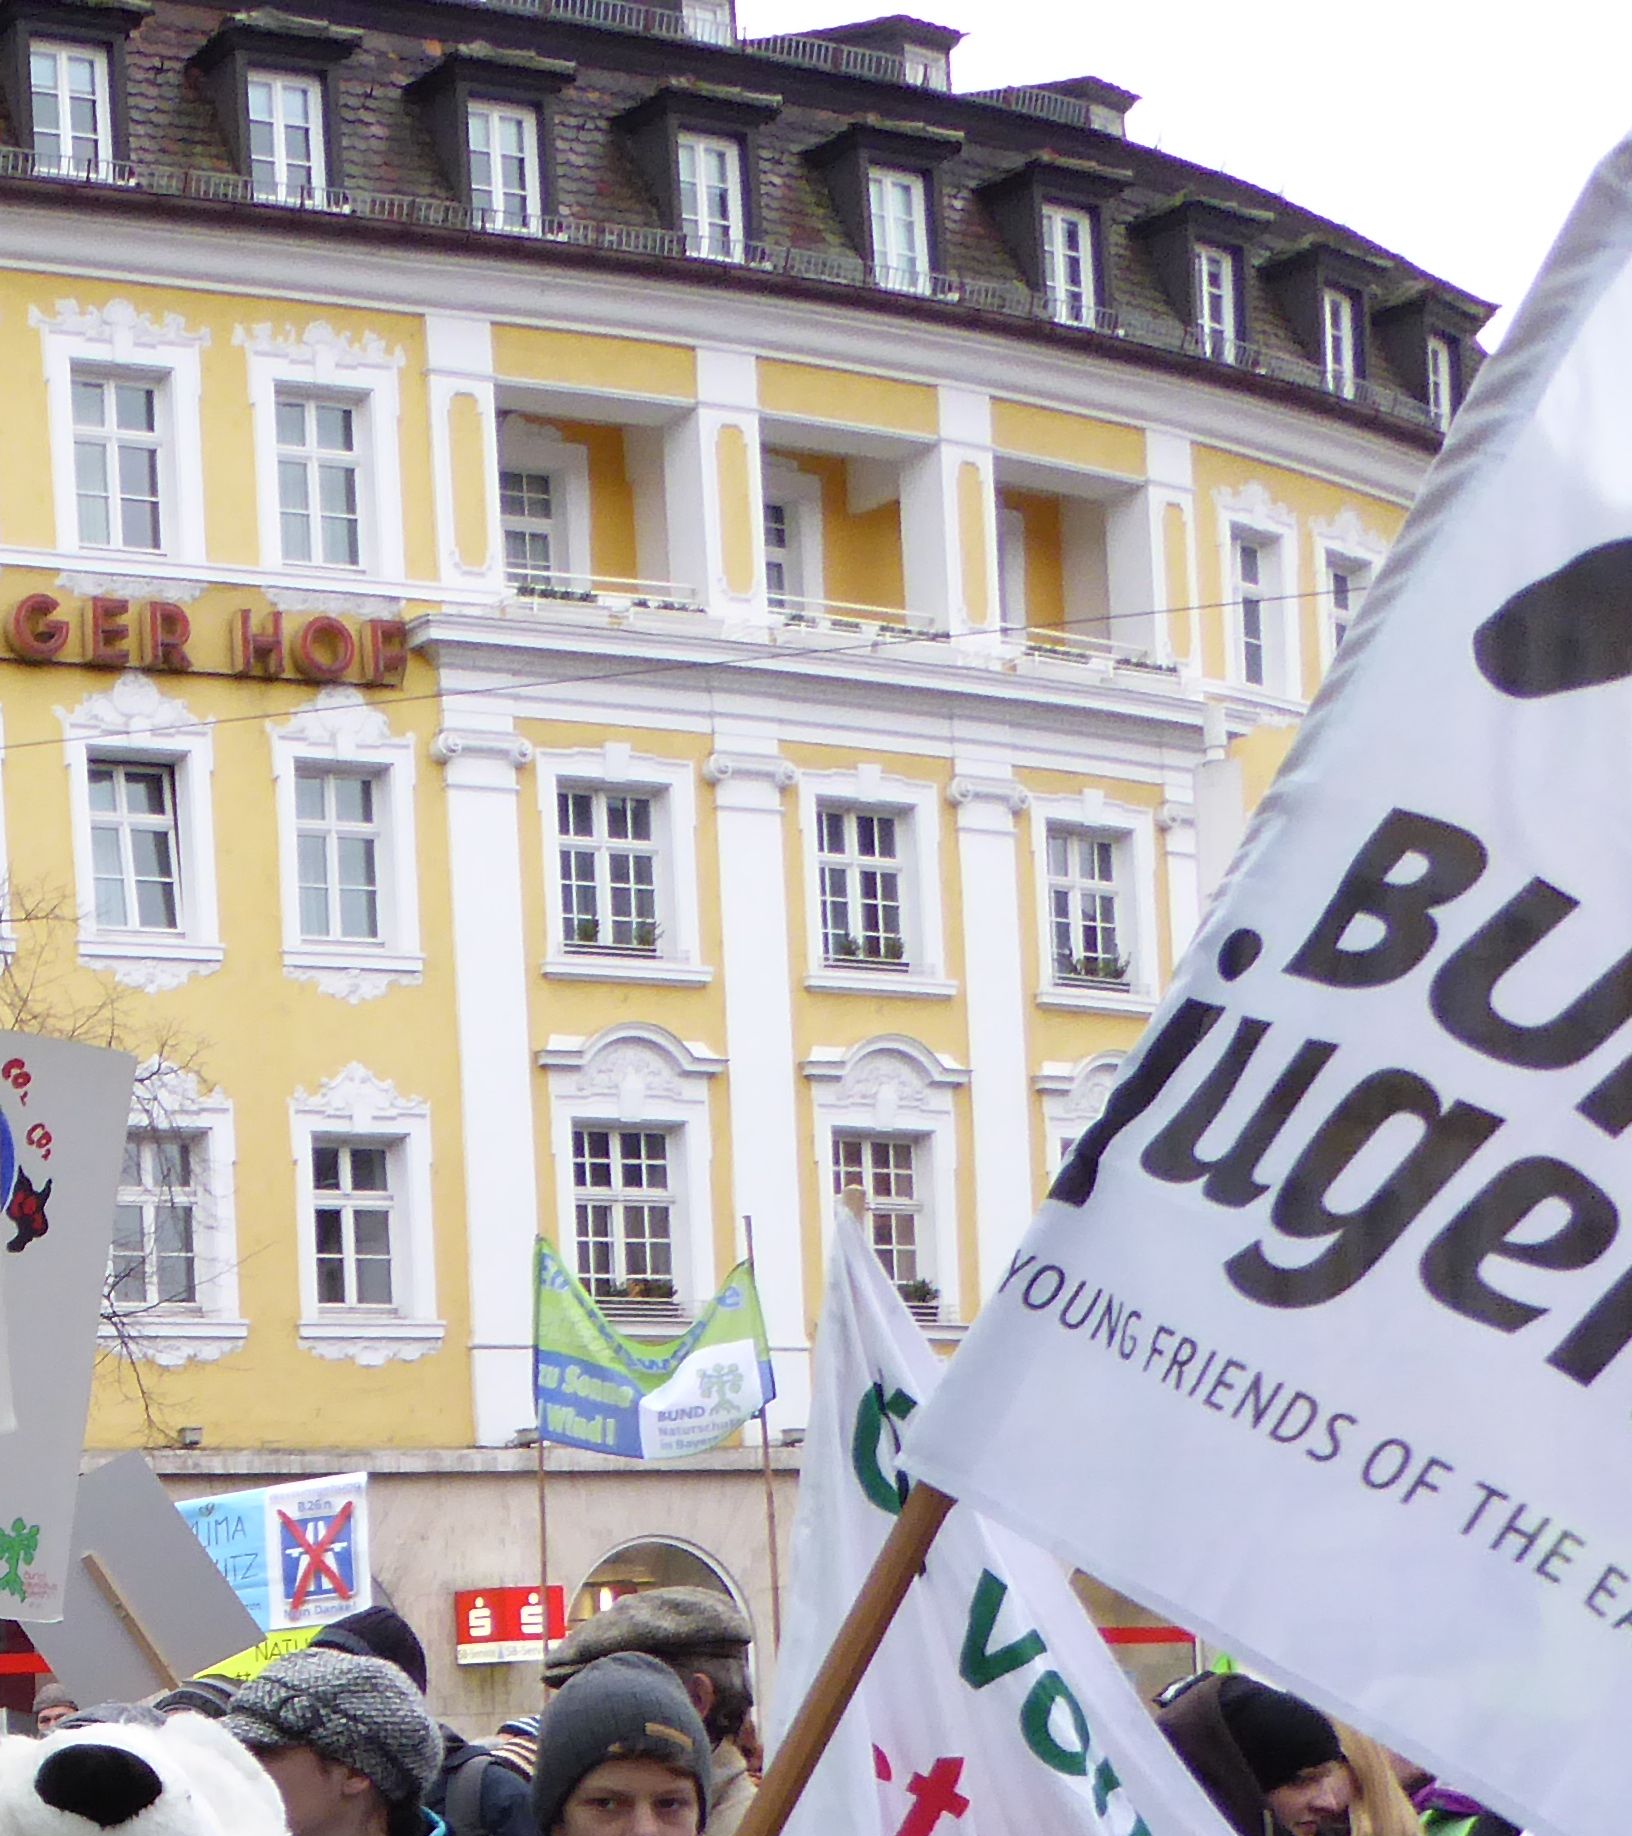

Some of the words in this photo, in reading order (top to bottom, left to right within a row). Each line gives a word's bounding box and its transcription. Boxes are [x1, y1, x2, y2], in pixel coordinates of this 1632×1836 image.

[234, 606, 408, 688] HOF
[997, 1249, 1141, 1360] YOUNG
[1142, 1325, 1358, 1463] FRIENDS
[1360, 1437, 1454, 1504] OF
[1458, 1481, 1586, 1584] THE
